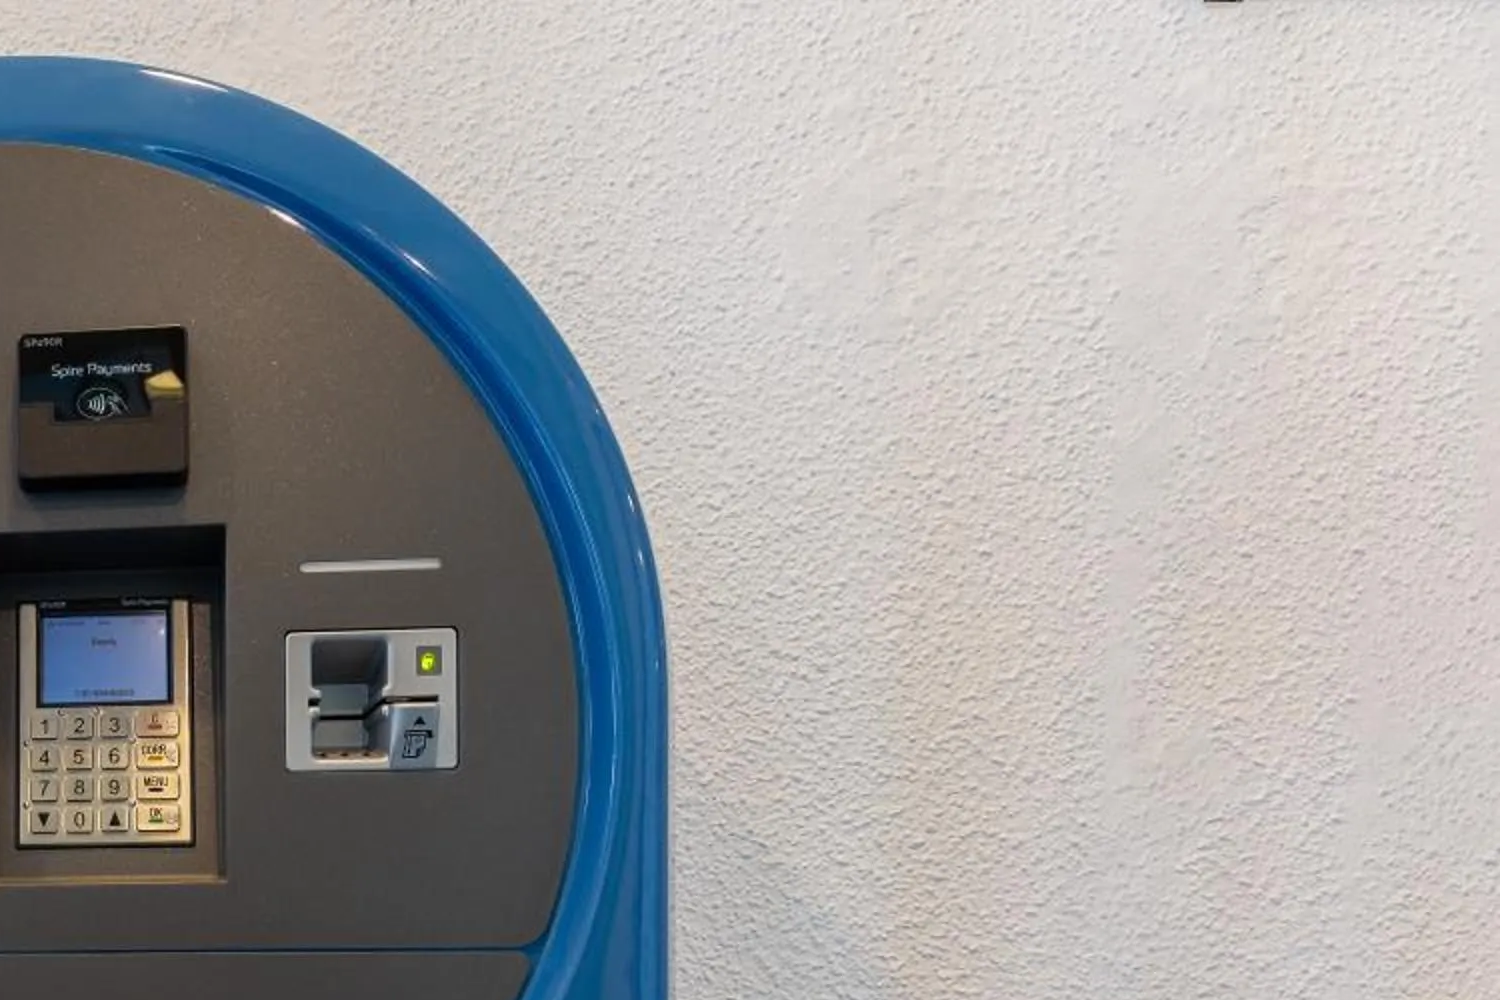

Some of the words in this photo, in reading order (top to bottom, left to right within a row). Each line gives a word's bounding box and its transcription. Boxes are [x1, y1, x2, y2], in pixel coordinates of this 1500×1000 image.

[51, 363, 84, 379] Spire
[87, 361, 153, 377] Payments
[41, 719, 49, 734] 1
[73, 718, 85, 733] 2
[109, 717, 121, 733] 3
[39, 751, 50, 765] 4
[73, 749, 85, 765] 5
[108, 748, 120, 764] 6
[40, 780, 50, 796] 7
[73, 779, 85, 795] 8
[108, 780, 120, 795] 9
[143, 775, 168, 787] MENU
[73, 812, 85, 828] 0
